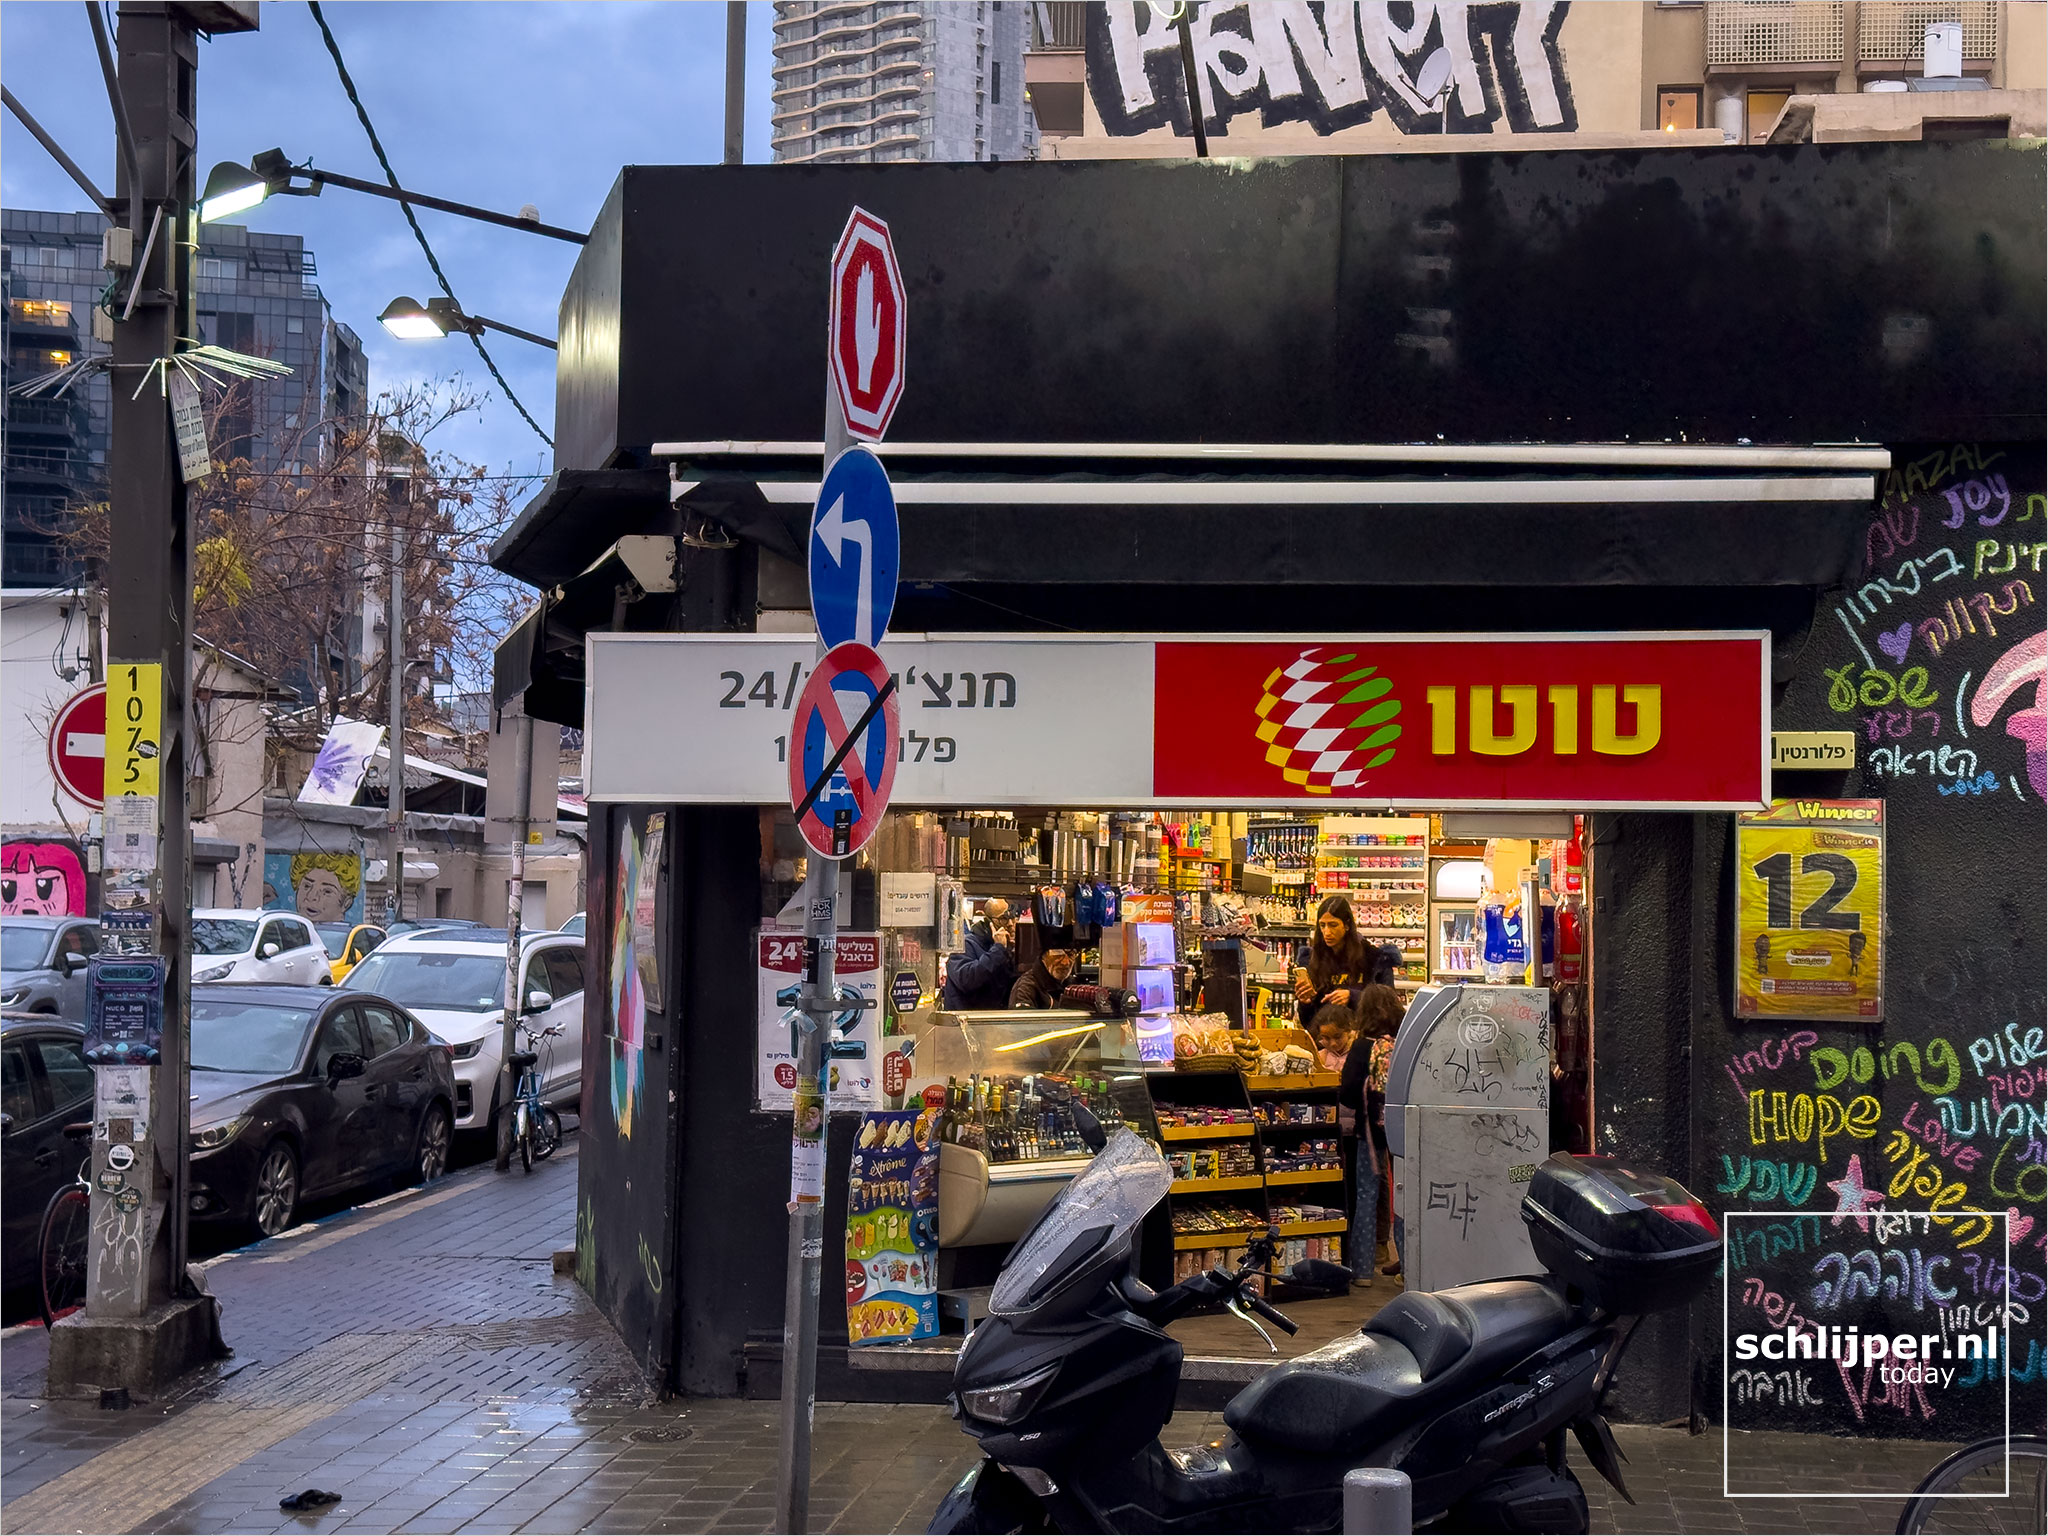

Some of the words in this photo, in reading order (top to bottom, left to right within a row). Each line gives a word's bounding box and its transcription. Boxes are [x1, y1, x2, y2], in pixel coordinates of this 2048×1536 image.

[1824, 662, 1940, 713] שפע
[1426, 684, 1662, 756] טוטו
[1781, 743, 1846, 763] פלורנטין
[1797, 801, 1878, 821] Winner
[1752, 852, 1862, 930] 12
[768, 942, 798, 961] 24
[781, 1071, 794, 1081] 1.5
[1716, 1154, 1818, 1207] שפע
[1019, 1432, 1041, 1442] 250
